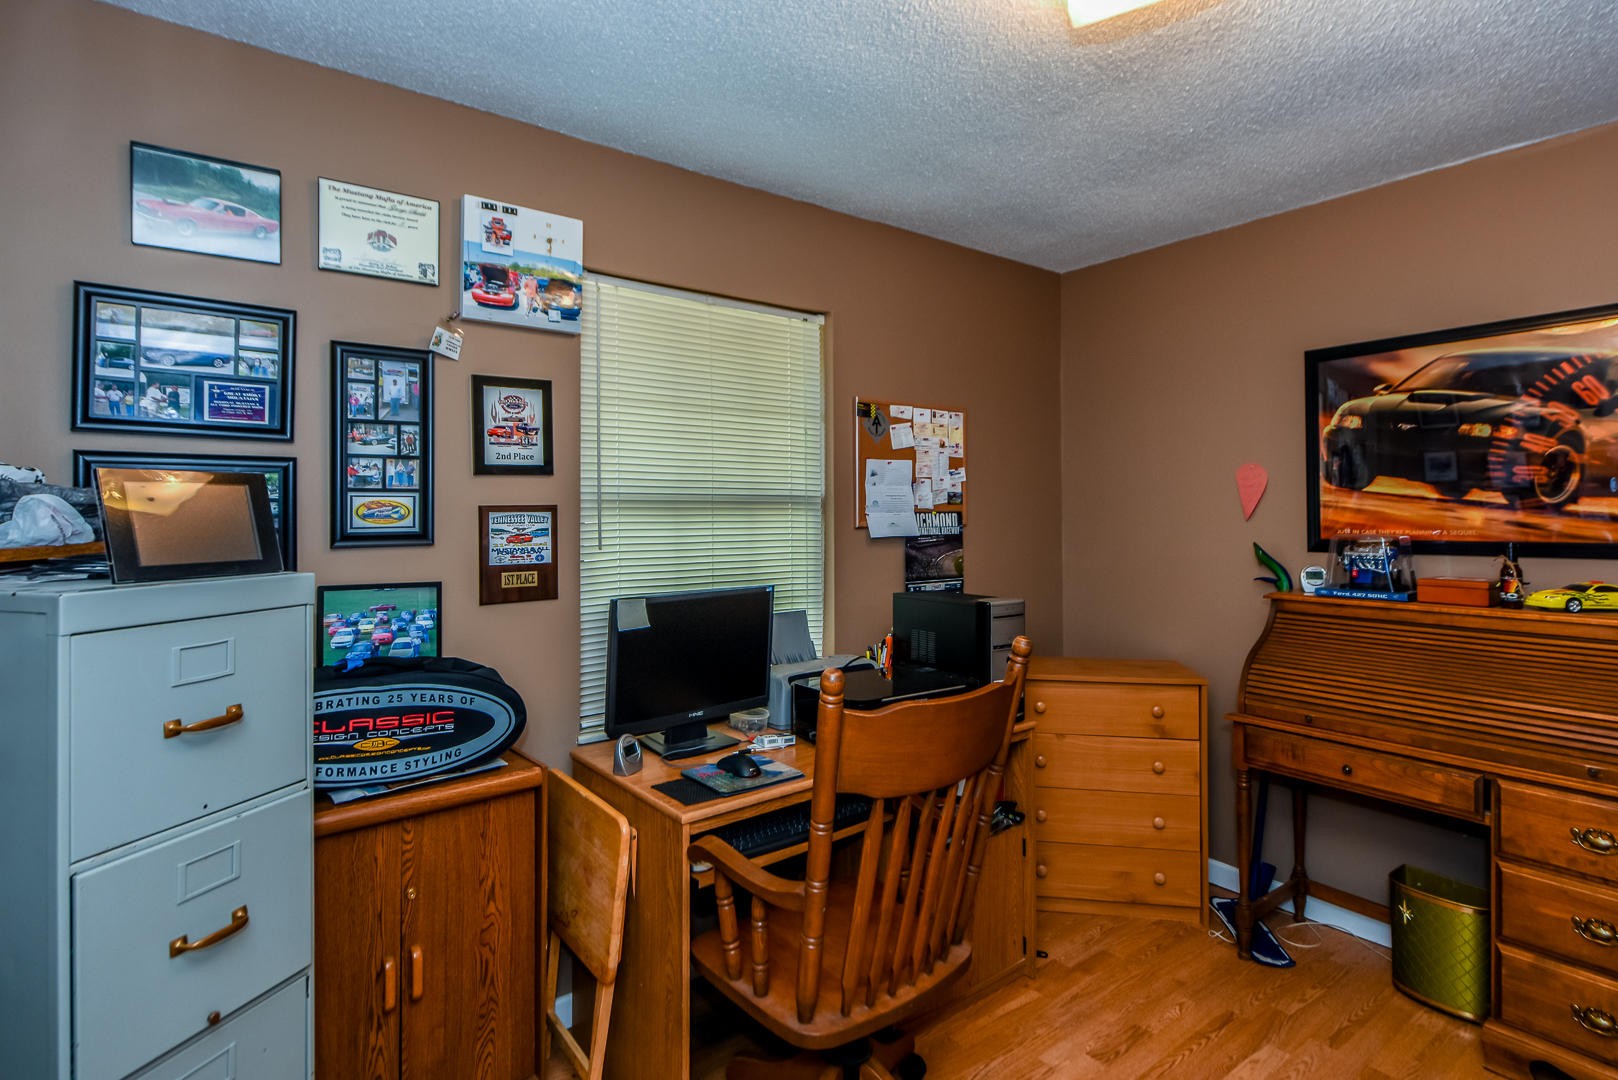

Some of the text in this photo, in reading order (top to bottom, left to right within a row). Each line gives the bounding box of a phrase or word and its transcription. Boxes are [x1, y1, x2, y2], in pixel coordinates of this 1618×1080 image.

[1571, 375, 1610, 405] 60
[495, 452, 535, 460] 2nd Place
[491, 514, 549, 524] TENNESSEE VALLEY
[916, 513, 958, 527] ICHMOND
[504, 573, 536, 586] 1ST PLACE
[315, 693, 476, 711] BRATING 25 YEARS OF
[313, 711, 454, 733] LASSIC
[313, 723, 455, 742] SIGN CONCEPTS
[315, 748, 463, 778] FORMANCE STYLING
